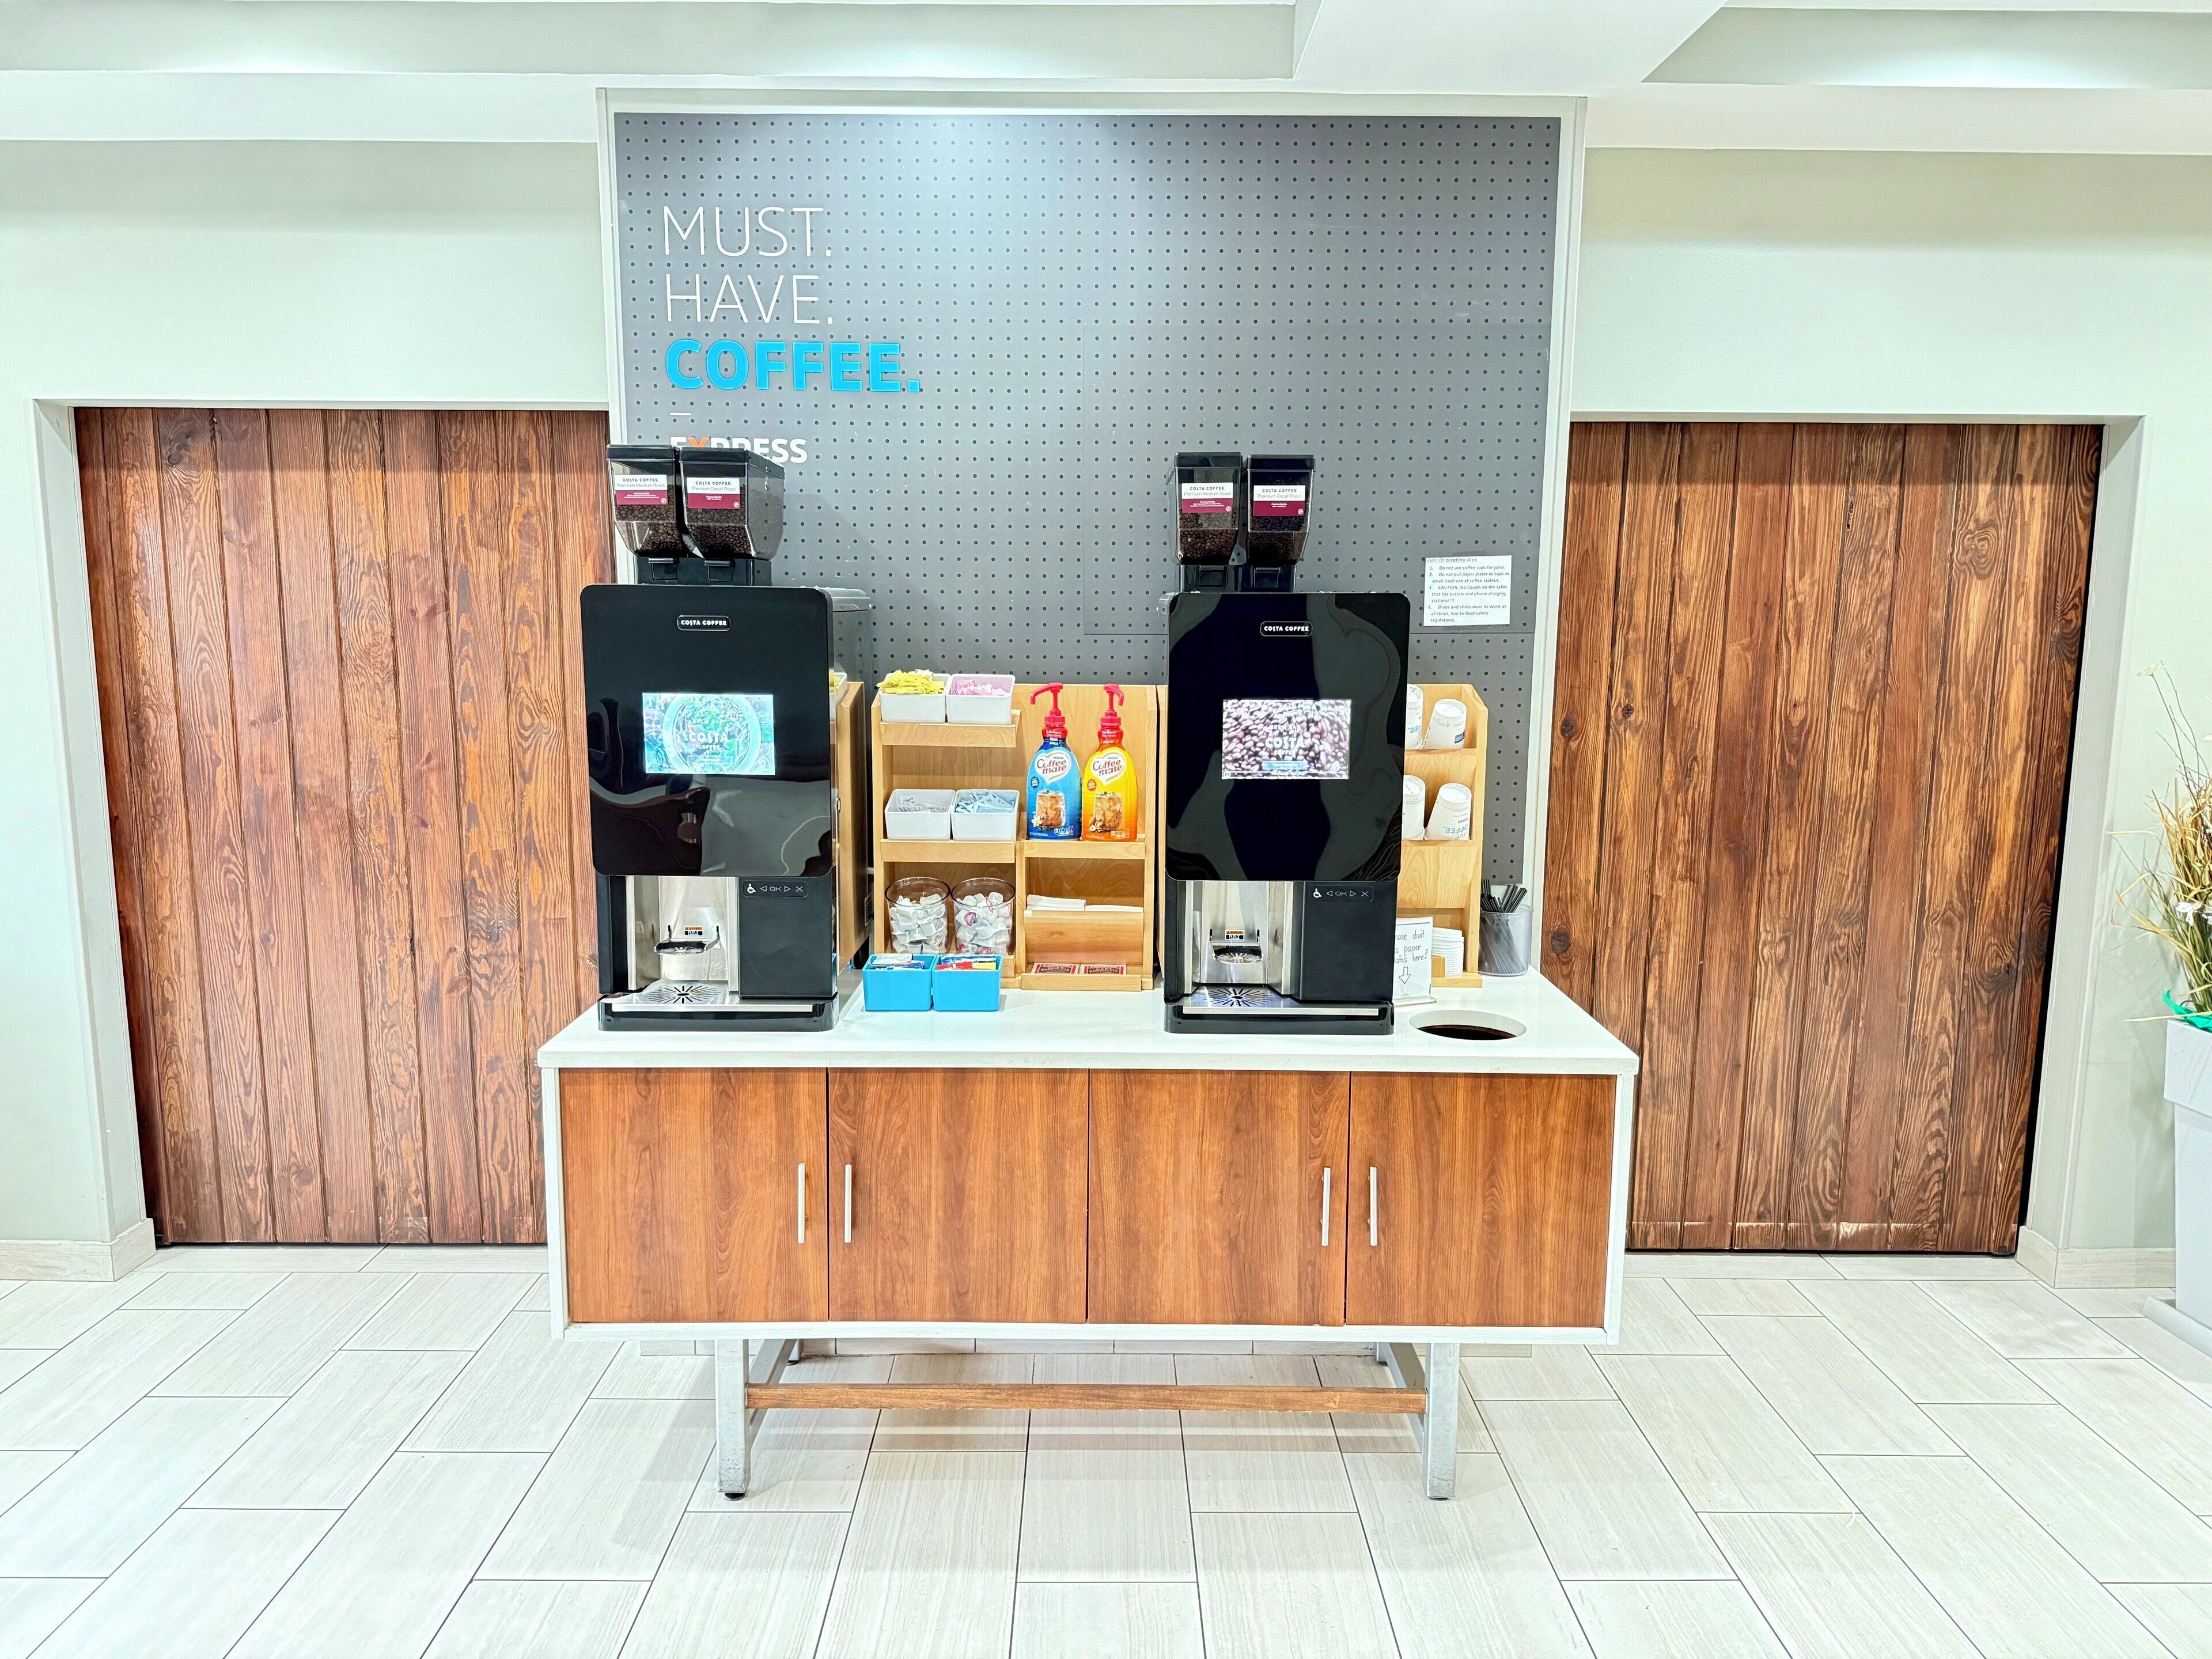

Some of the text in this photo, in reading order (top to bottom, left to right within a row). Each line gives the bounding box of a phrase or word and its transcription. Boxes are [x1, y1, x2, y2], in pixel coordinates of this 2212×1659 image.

[663, 206, 832, 257] MUST.
[665, 273, 834, 324] HAVE.
[665, 339, 921, 393] COFFEE.
[688, 728, 729, 743] COSTA
[1265, 734, 1305, 749] COSTA
[1037, 759, 1066, 769] Coffee
[1042, 765, 1067, 774] mate
[1093, 759, 1121, 771] Coffee
[1099, 765, 1122, 776] mate
[1443, 824, 1468, 834] OFFEE.
[1412, 929, 1425, 940] don't
[1404, 945, 1422, 957] paper
